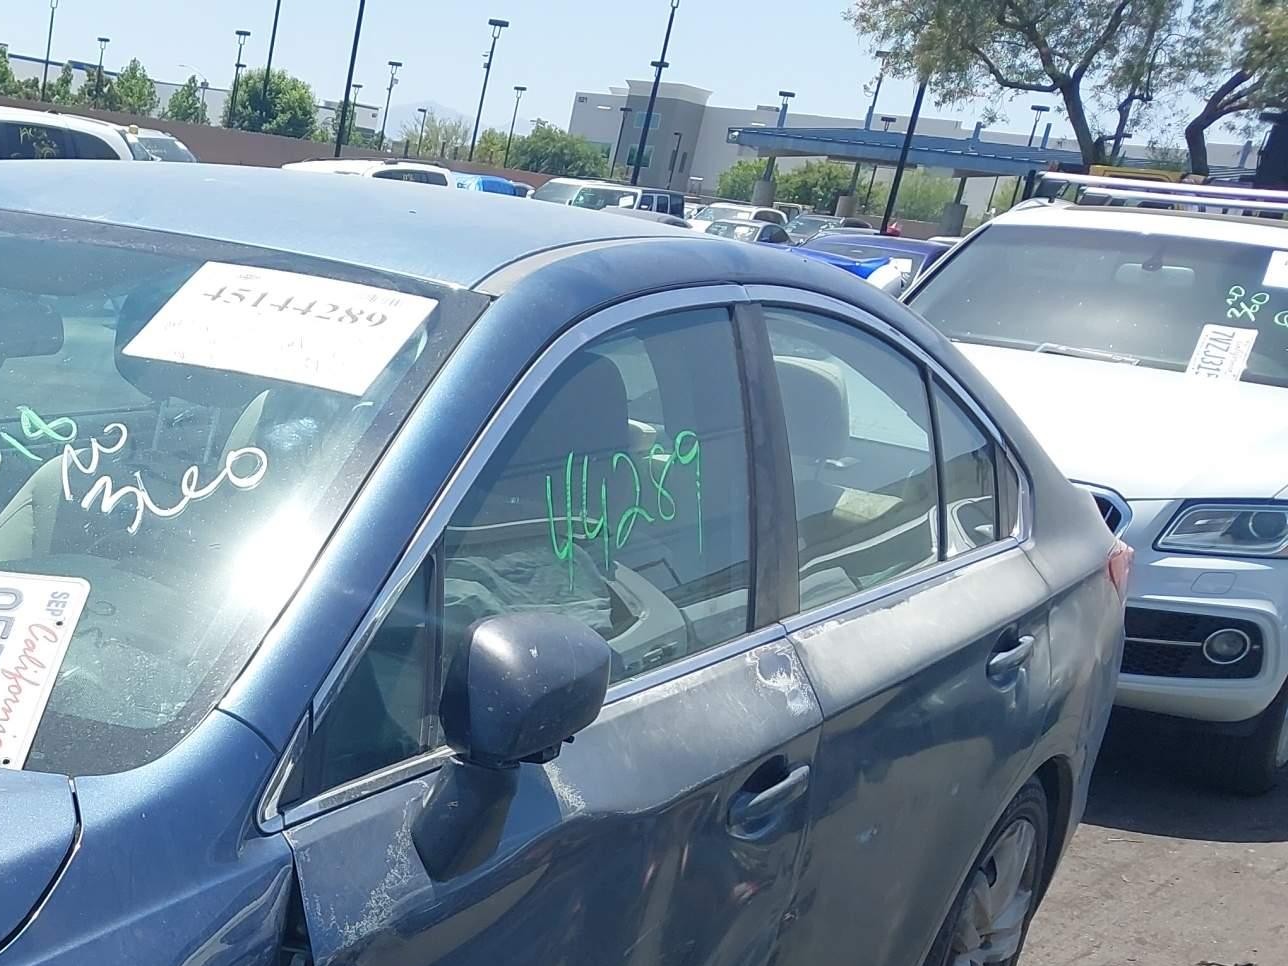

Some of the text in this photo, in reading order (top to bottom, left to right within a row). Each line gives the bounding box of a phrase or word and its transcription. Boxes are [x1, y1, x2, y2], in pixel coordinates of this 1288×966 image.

[202, 284, 389, 328] 45144289
[546, 430, 703, 592] 44289
[45, 591, 70, 618] SEP
